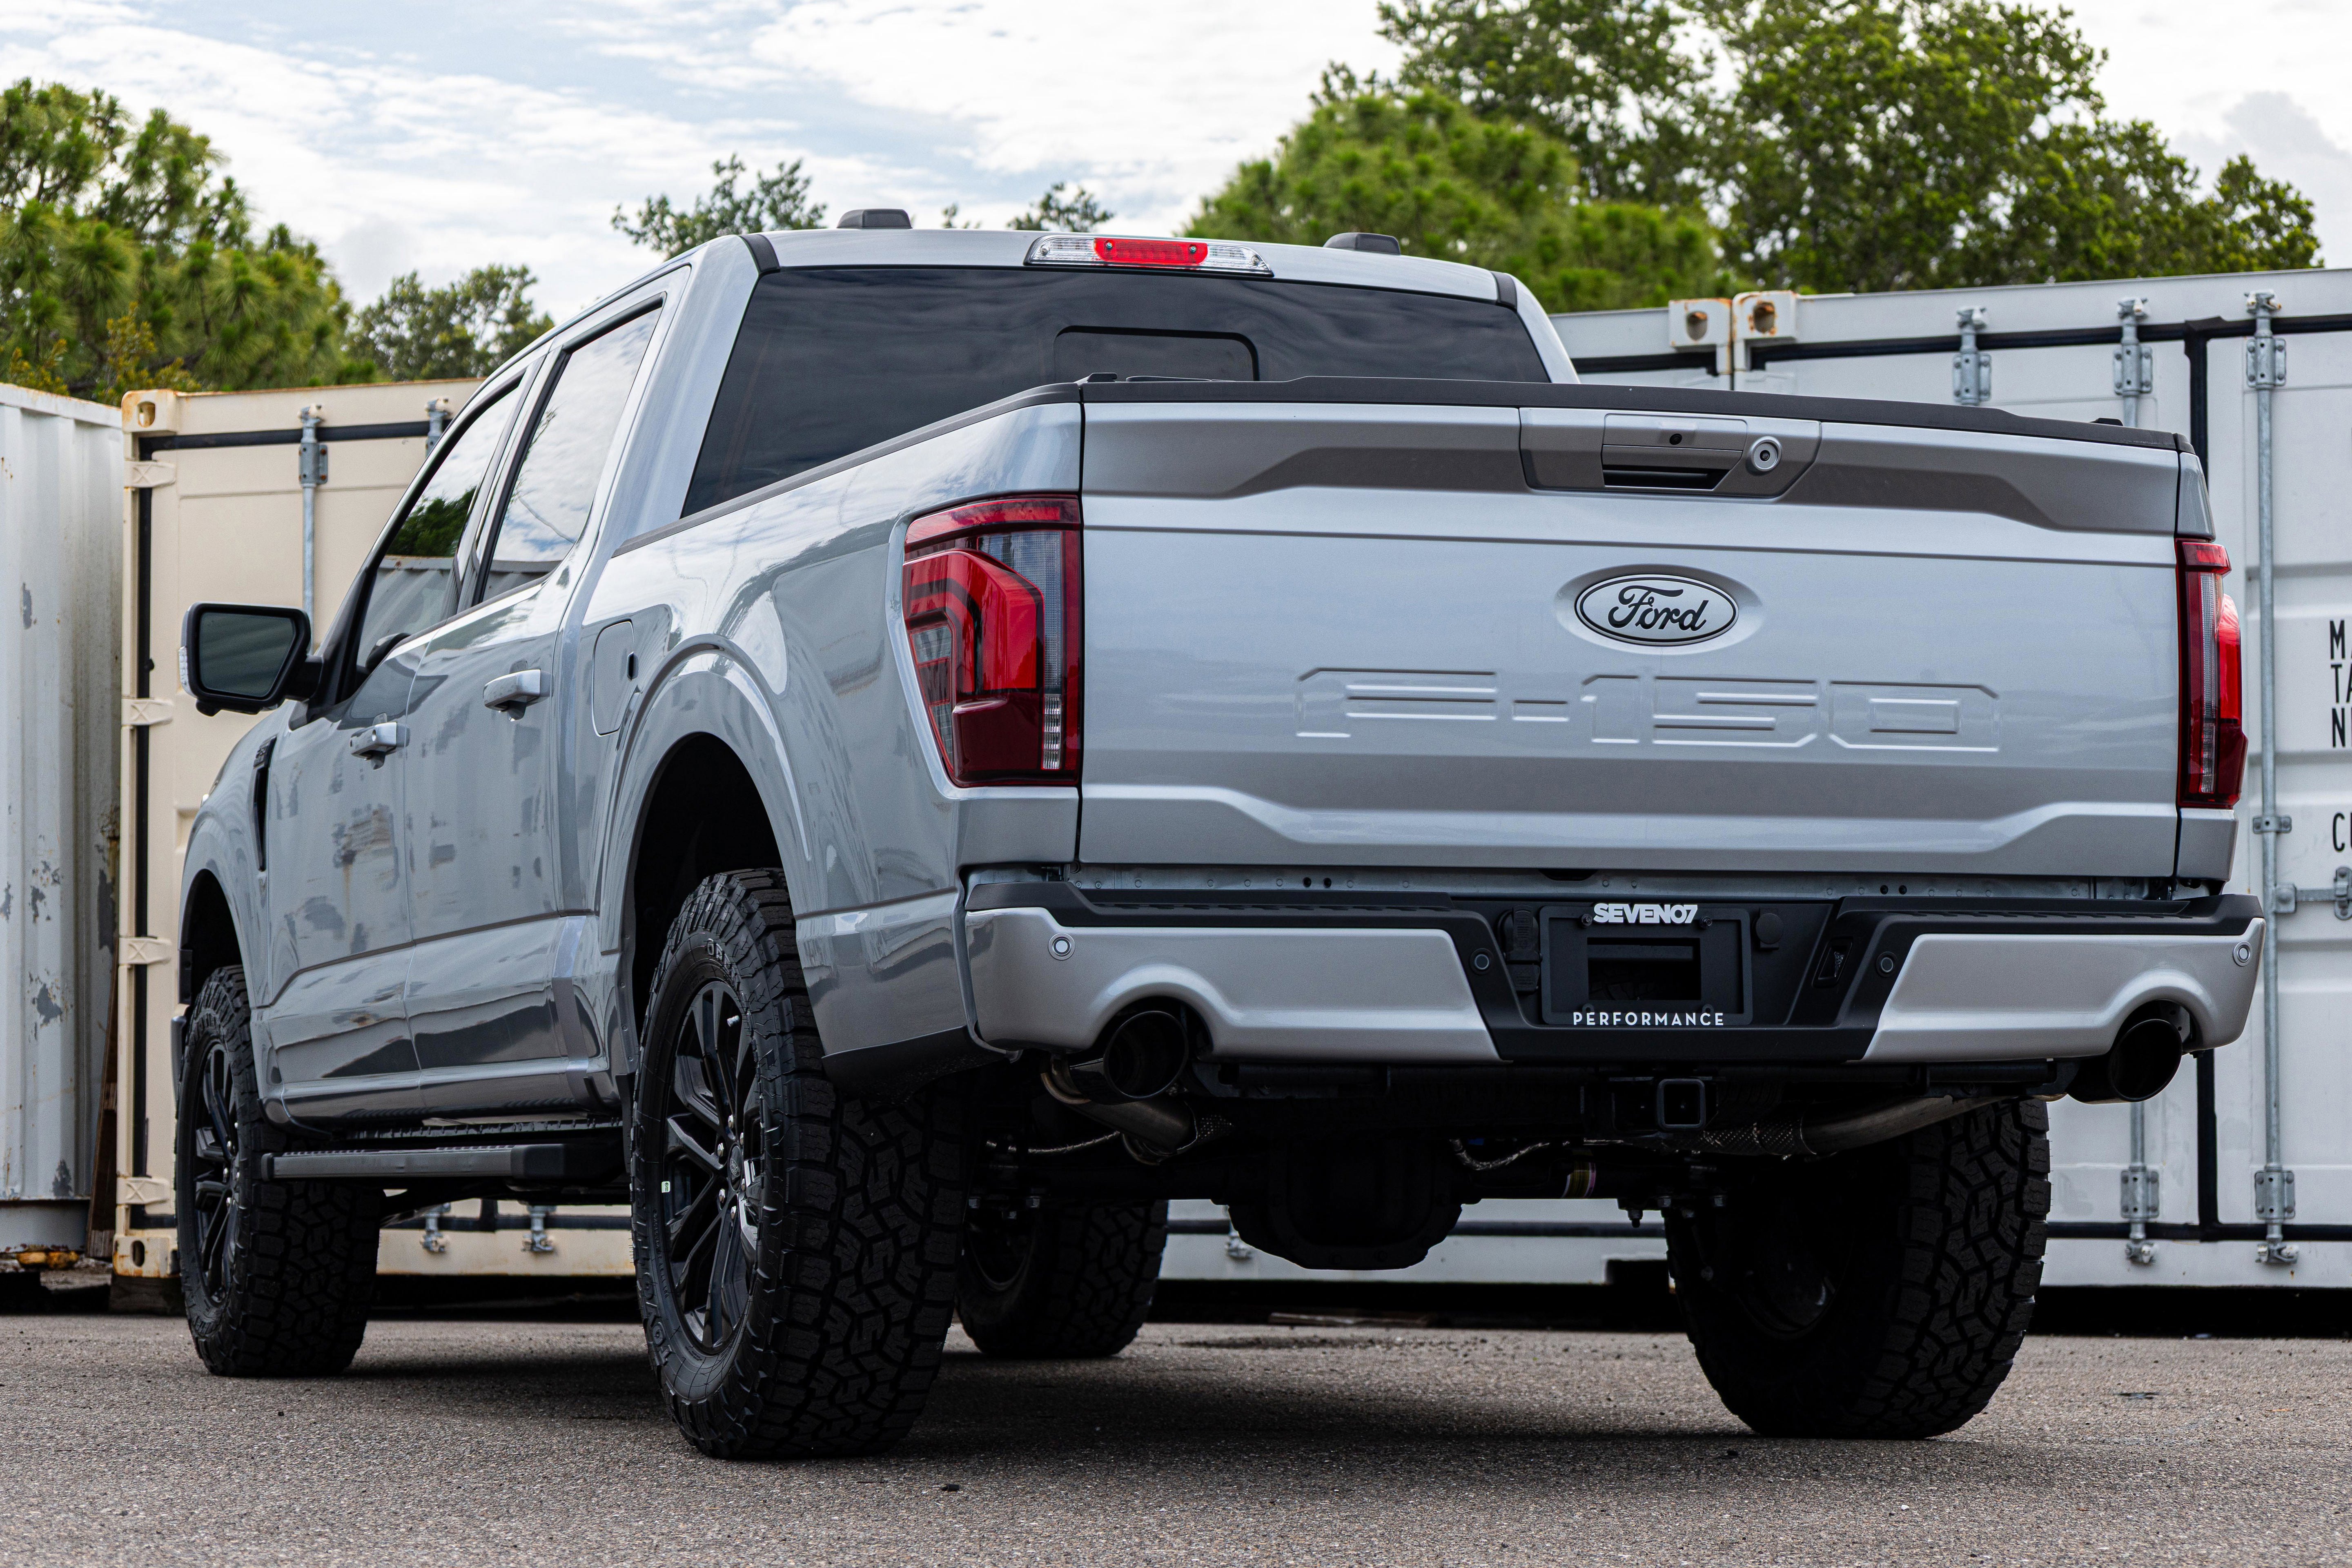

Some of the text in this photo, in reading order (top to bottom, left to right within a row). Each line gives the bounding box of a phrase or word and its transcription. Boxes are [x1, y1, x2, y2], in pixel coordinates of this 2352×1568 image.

[1608, 585, 1709, 632] Ford
[2330, 620, 2352, 659] M
[2332, 707, 2352, 748] N
[2333, 812, 2352, 853] C
[1572, 1011, 1724, 1026] PERFORMANCE
